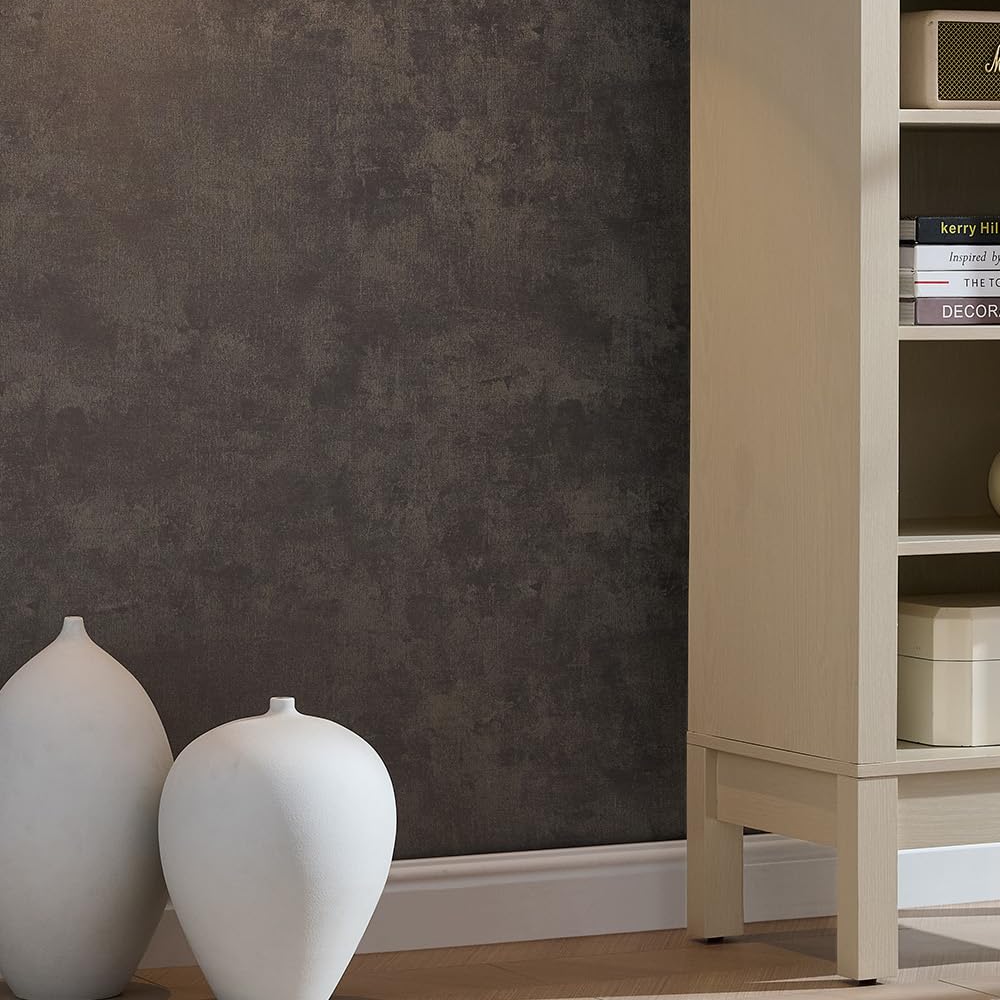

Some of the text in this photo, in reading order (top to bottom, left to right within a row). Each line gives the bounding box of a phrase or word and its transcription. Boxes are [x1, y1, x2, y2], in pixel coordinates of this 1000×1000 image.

[941, 222, 976, 236] kerry
[949, 251, 987, 266] Inspired
[964, 279, 985, 287] THE
